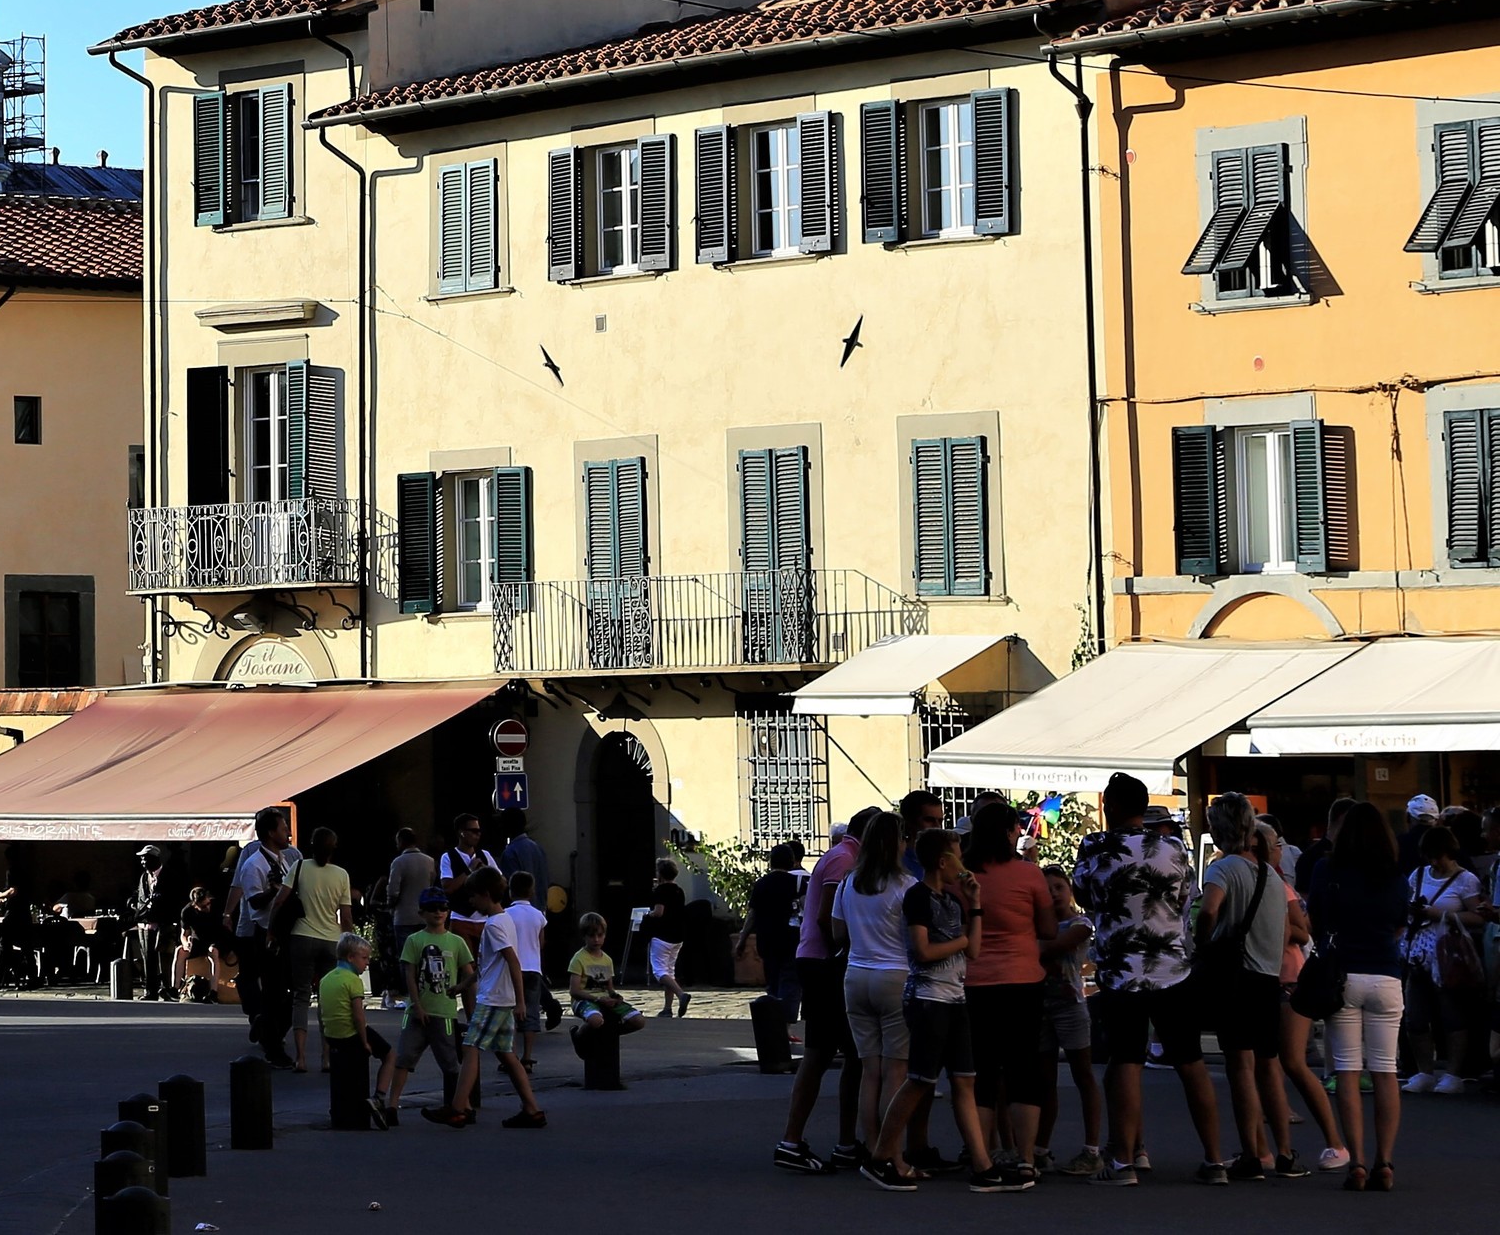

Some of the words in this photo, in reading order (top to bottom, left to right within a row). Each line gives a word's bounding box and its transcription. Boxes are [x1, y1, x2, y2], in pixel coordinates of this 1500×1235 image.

[262, 645, 276, 662] il
[238, 654, 305, 676] Toscano
[1334, 732, 1416, 747] Gelateria
[1013, 768, 1088, 783] Fotografo
